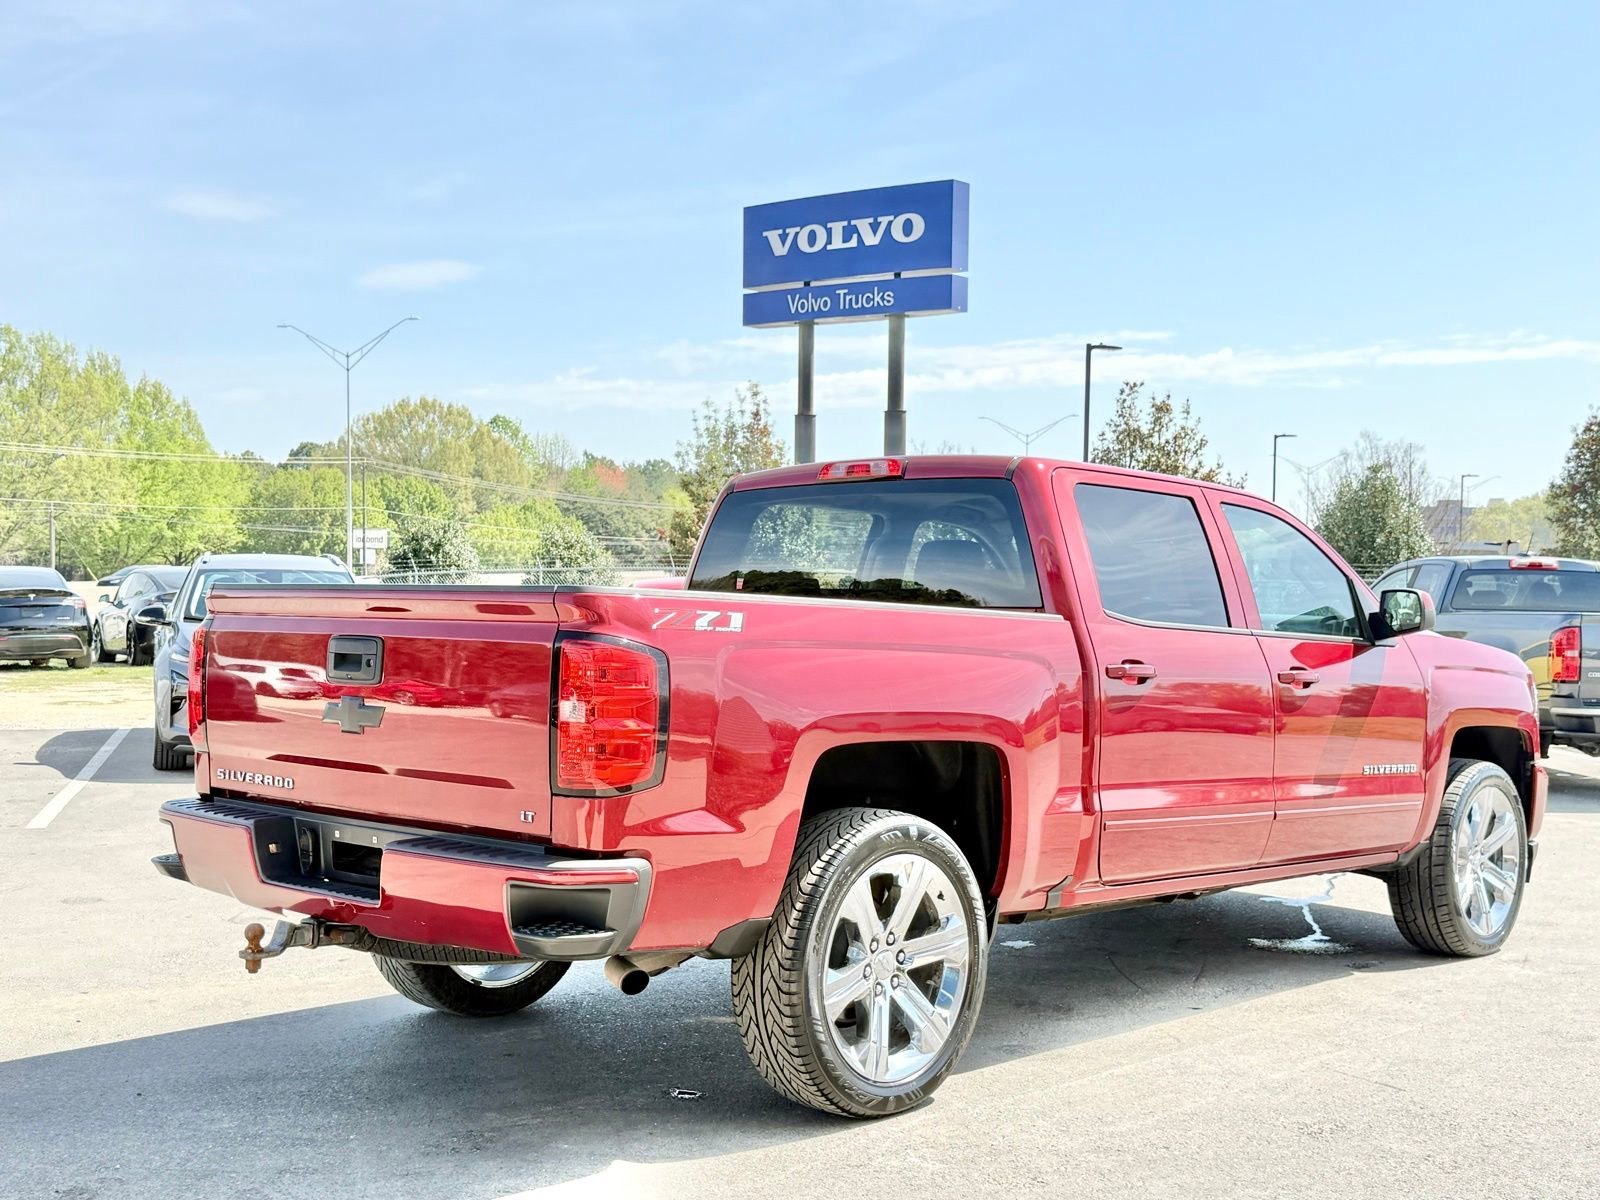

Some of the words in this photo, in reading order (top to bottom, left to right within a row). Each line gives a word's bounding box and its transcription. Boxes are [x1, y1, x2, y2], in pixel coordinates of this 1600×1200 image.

[762, 212, 926, 257] VOLVO
[787, 294, 831, 314] Volvo
[835, 286, 895, 310] Trucks
[651, 607, 744, 630] Z71
[216, 768, 295, 789] SILVERADO
[1362, 763, 1417, 775] SILVERADO
[520, 810, 536, 823] LT
